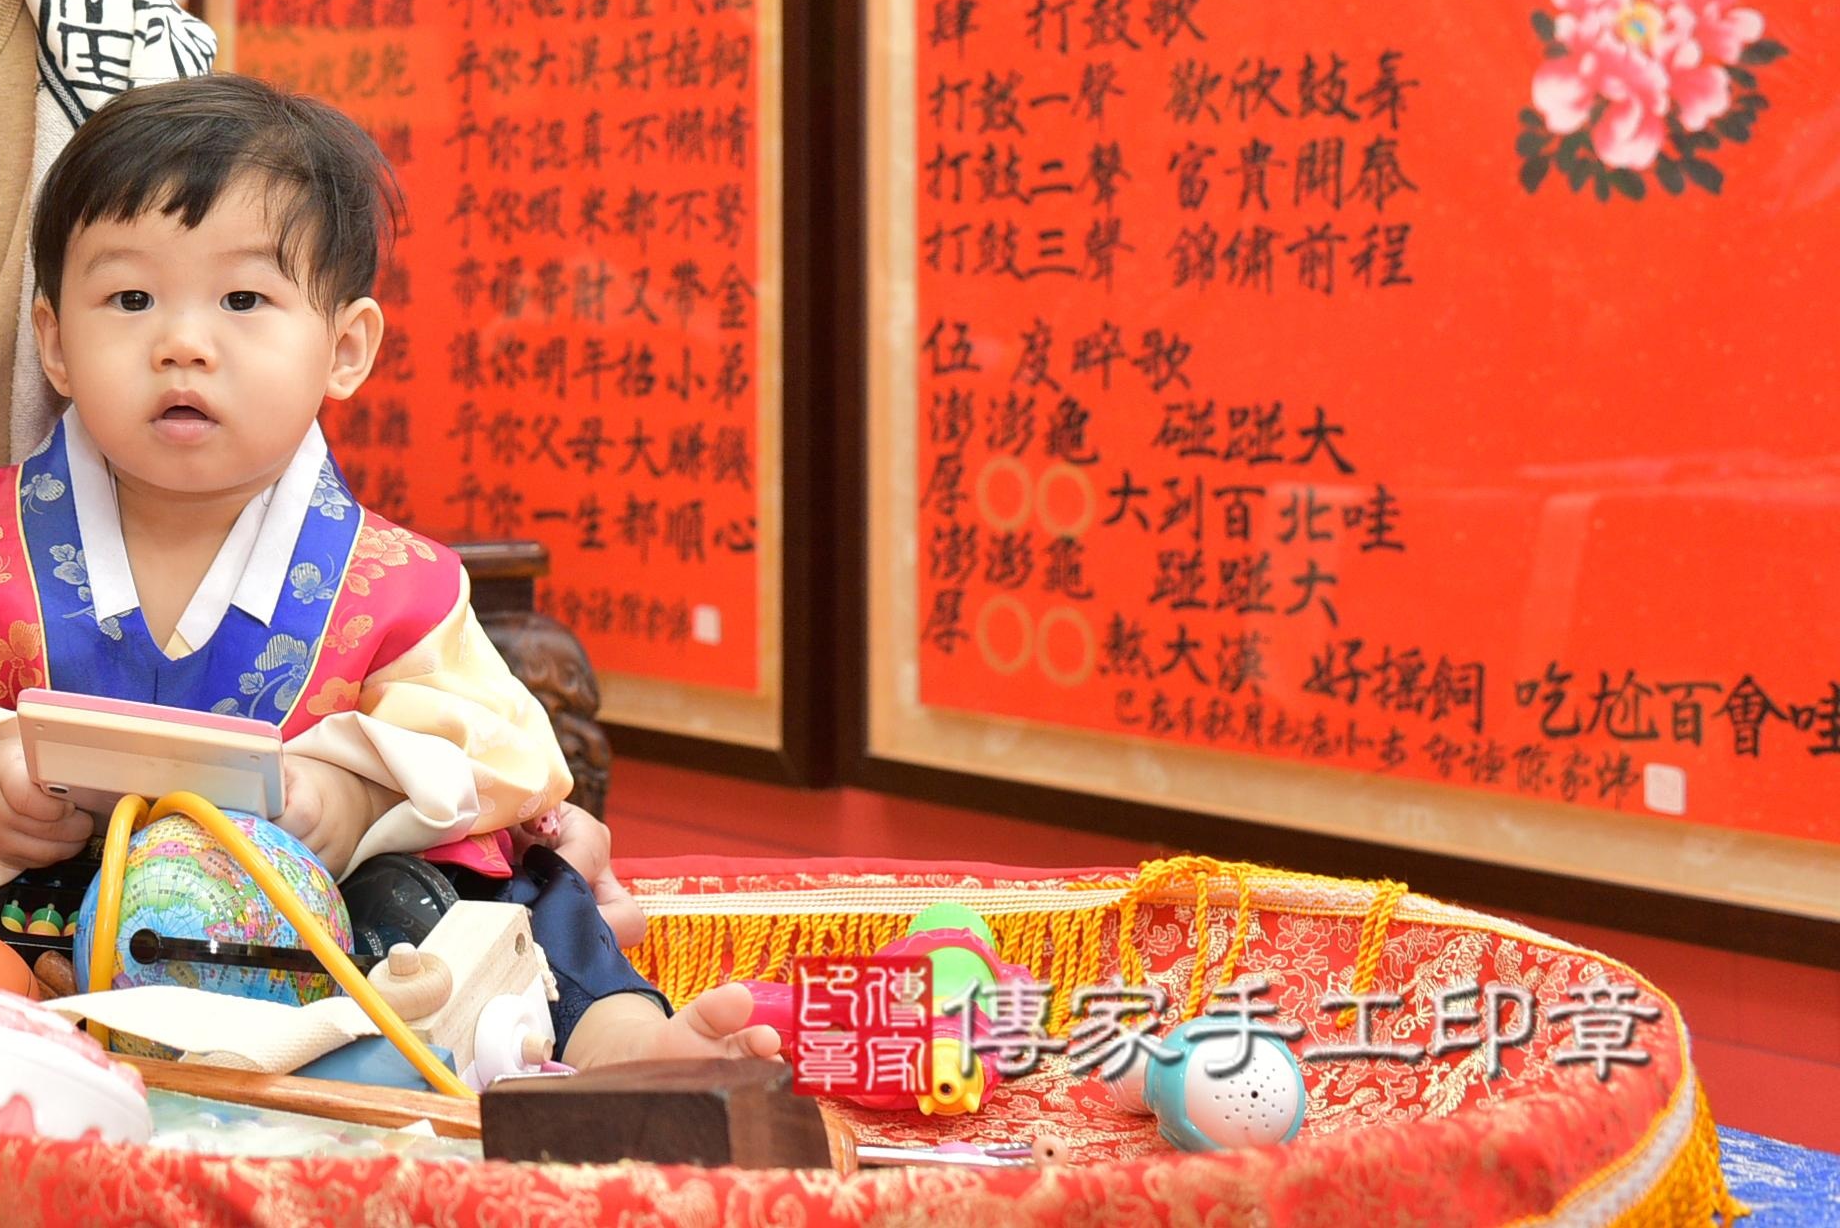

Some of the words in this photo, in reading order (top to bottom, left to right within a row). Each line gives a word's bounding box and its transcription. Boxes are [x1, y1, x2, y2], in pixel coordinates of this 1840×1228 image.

[927, 62, 1124, 137] 打鼓一聲
[1166, 50, 1420, 130] 歡欣鼓舞
[925, 142, 1133, 227] 打鼓二聲
[1166, 135, 1420, 214] 富貴開泰
[923, 221, 1134, 293] 打鼓三聲
[923, 318, 982, 376] 伍
[446, 480, 756, 562] 乎你一生都順心
